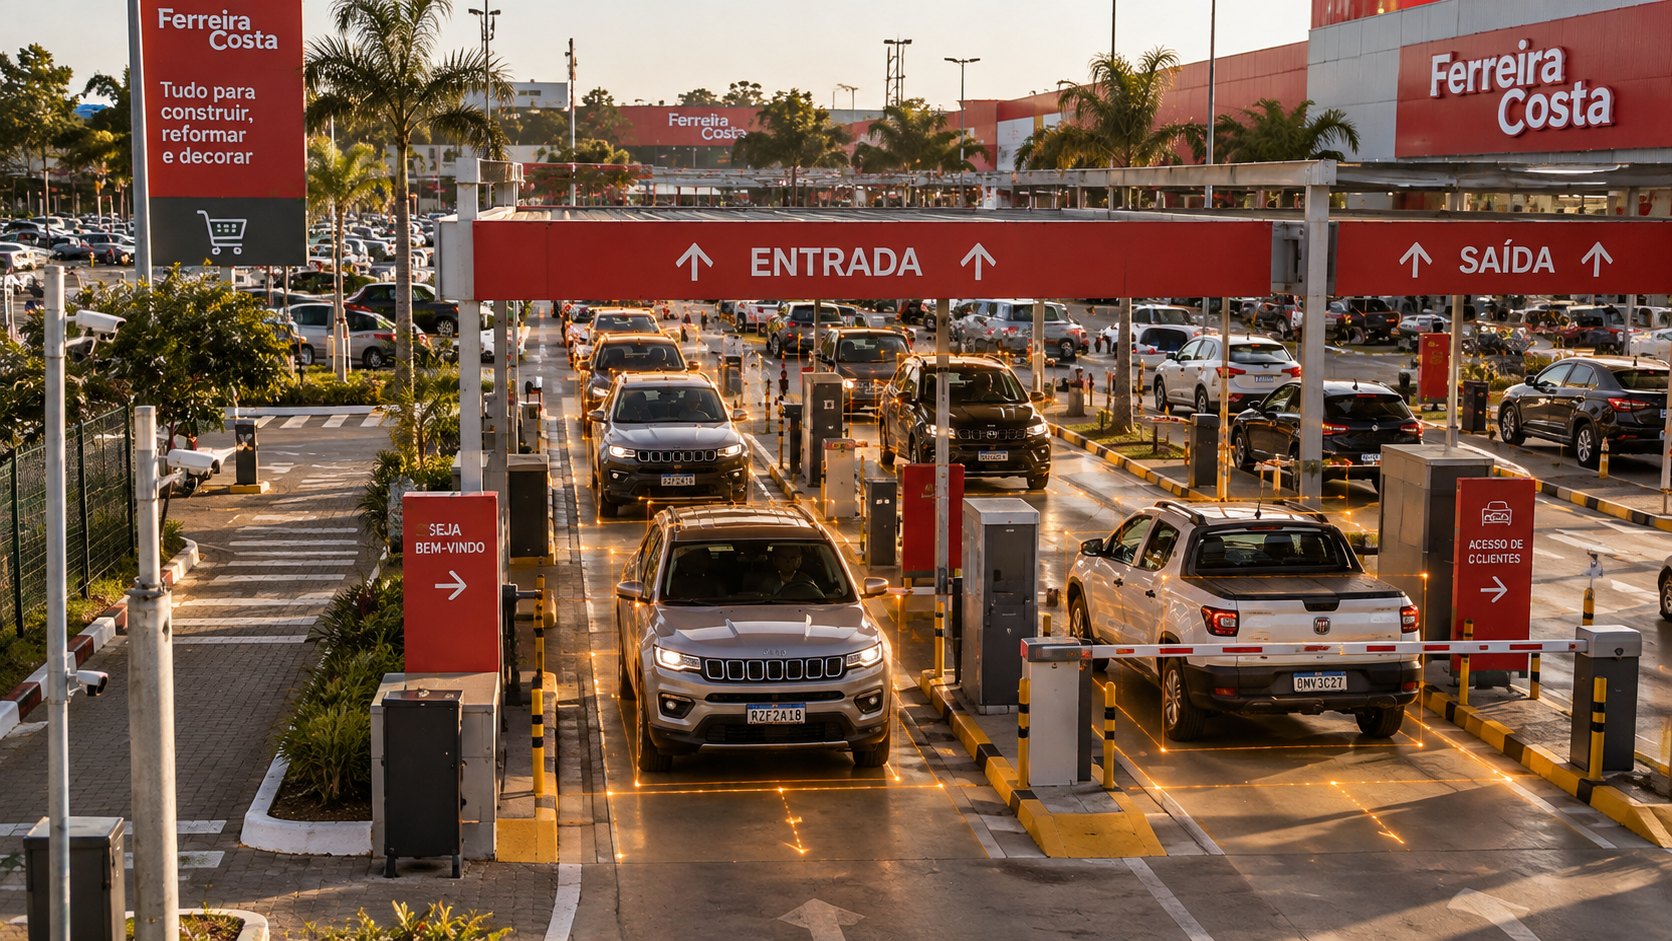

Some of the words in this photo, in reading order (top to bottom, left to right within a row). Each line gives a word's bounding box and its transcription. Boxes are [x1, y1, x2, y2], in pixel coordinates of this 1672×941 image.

[158, 7, 251, 31] Ferreira
[209, 29, 278, 51] Costa
[1430, 39, 1564, 97] Ferreira
[160, 81, 208, 99] Tudo
[213, 86, 256, 102] para
[161, 103, 254, 124] construir,
[1498, 80, 1612, 136] Costa
[162, 124, 247, 143] reformar
[162, 151, 174, 164] e
[179, 147, 254, 165] decorar
[751, 247, 923, 277] ENTRADA
[1459, 239, 1555, 274] SAÍDA
[428, 523, 462, 536] SEJA
[415, 541, 485, 554] BEM-VINDO
[1469, 539, 1508, 550] ACESSO
[1510, 539, 1524, 550] DE
[751, 709, 802, 722] RZF2A18
